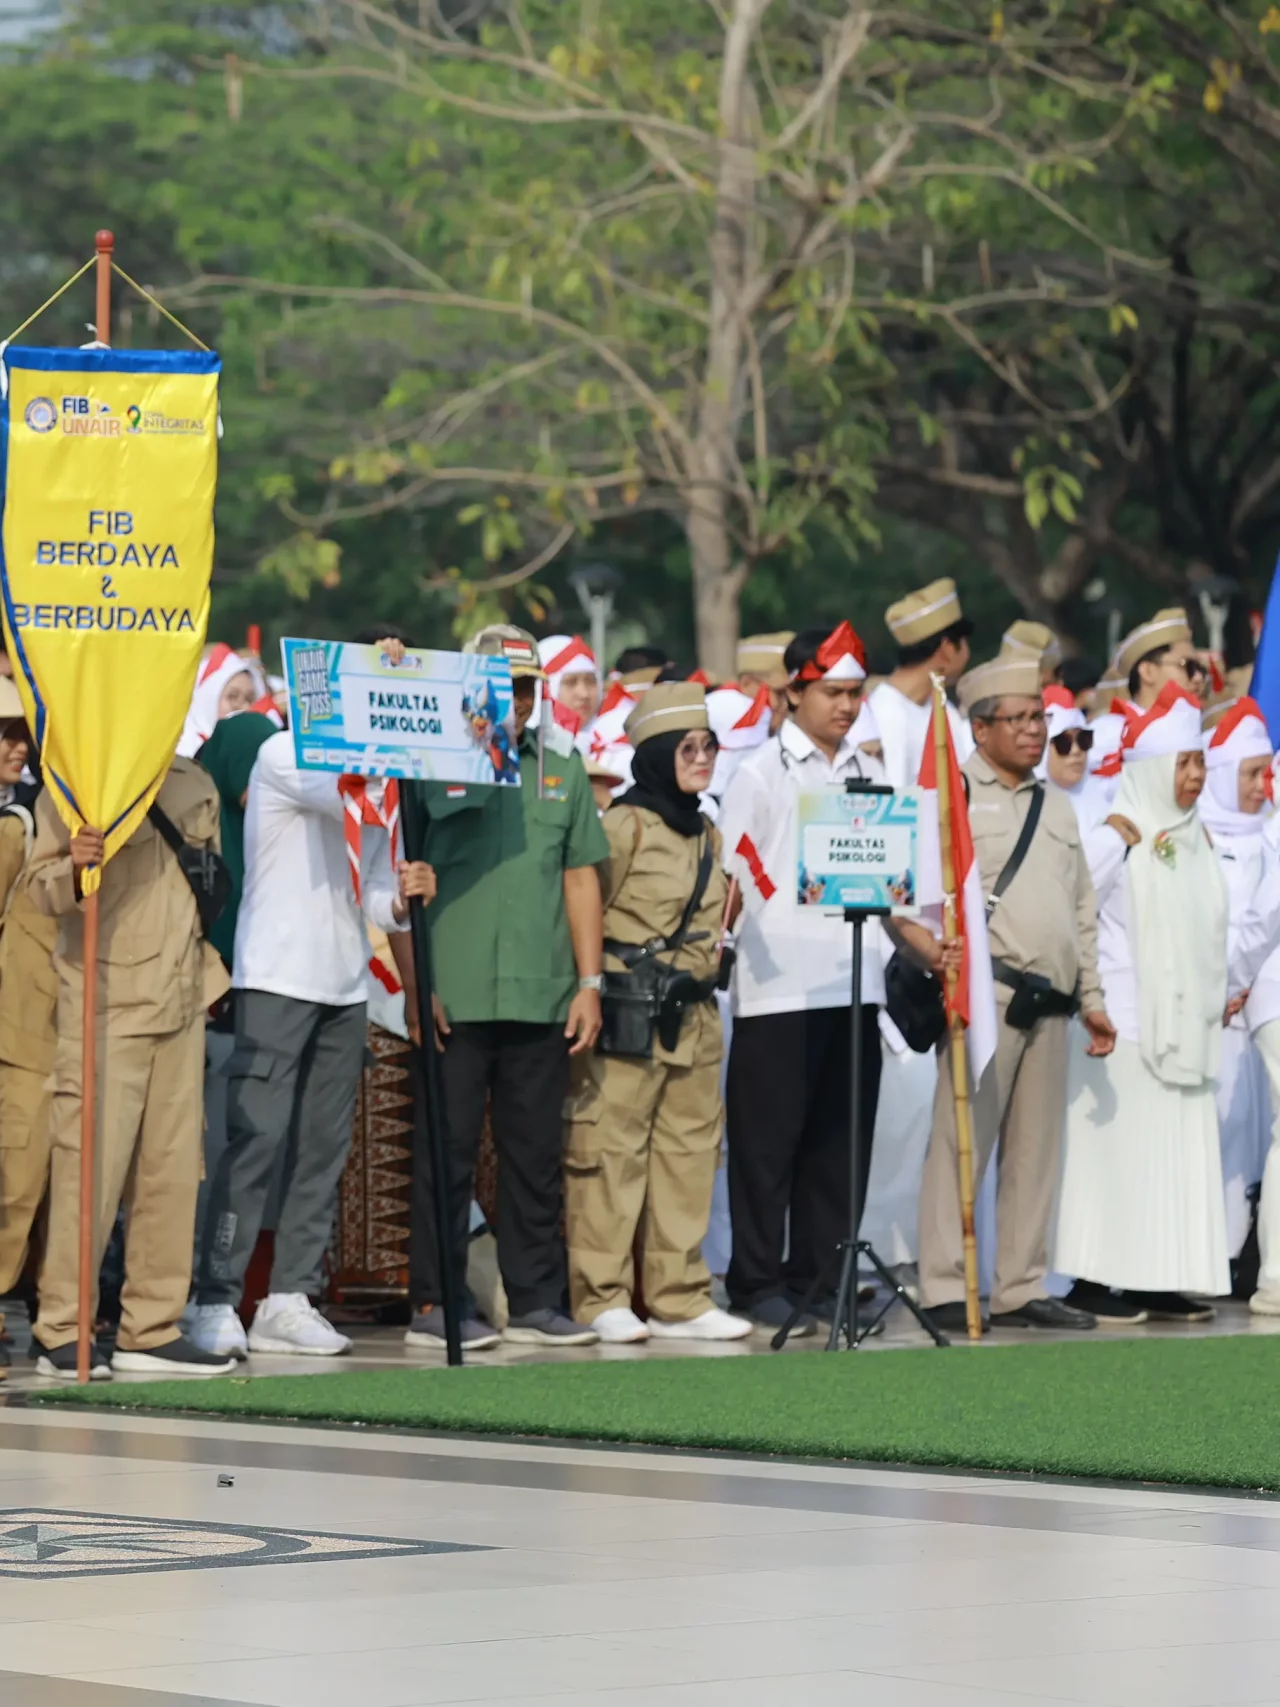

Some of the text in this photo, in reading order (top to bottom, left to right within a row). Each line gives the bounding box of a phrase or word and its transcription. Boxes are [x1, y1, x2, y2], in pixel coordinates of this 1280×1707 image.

[63, 398, 89, 414] FIB
[62, 418, 120, 436] UNAIR
[144, 417, 205, 430] INTEGRITAS
[89, 511, 133, 535] FIB
[36, 541, 180, 568] BERDAYA
[13, 603, 196, 632] BERBUDAYA
[299, 672, 328, 693] GAME
[369, 691, 439, 712] FAKULTAS
[370, 714, 442, 734] PSIKOLOGI
[830, 838, 885, 849] FAKULTAS
[829, 852, 886, 863] PSIKOLOGI
